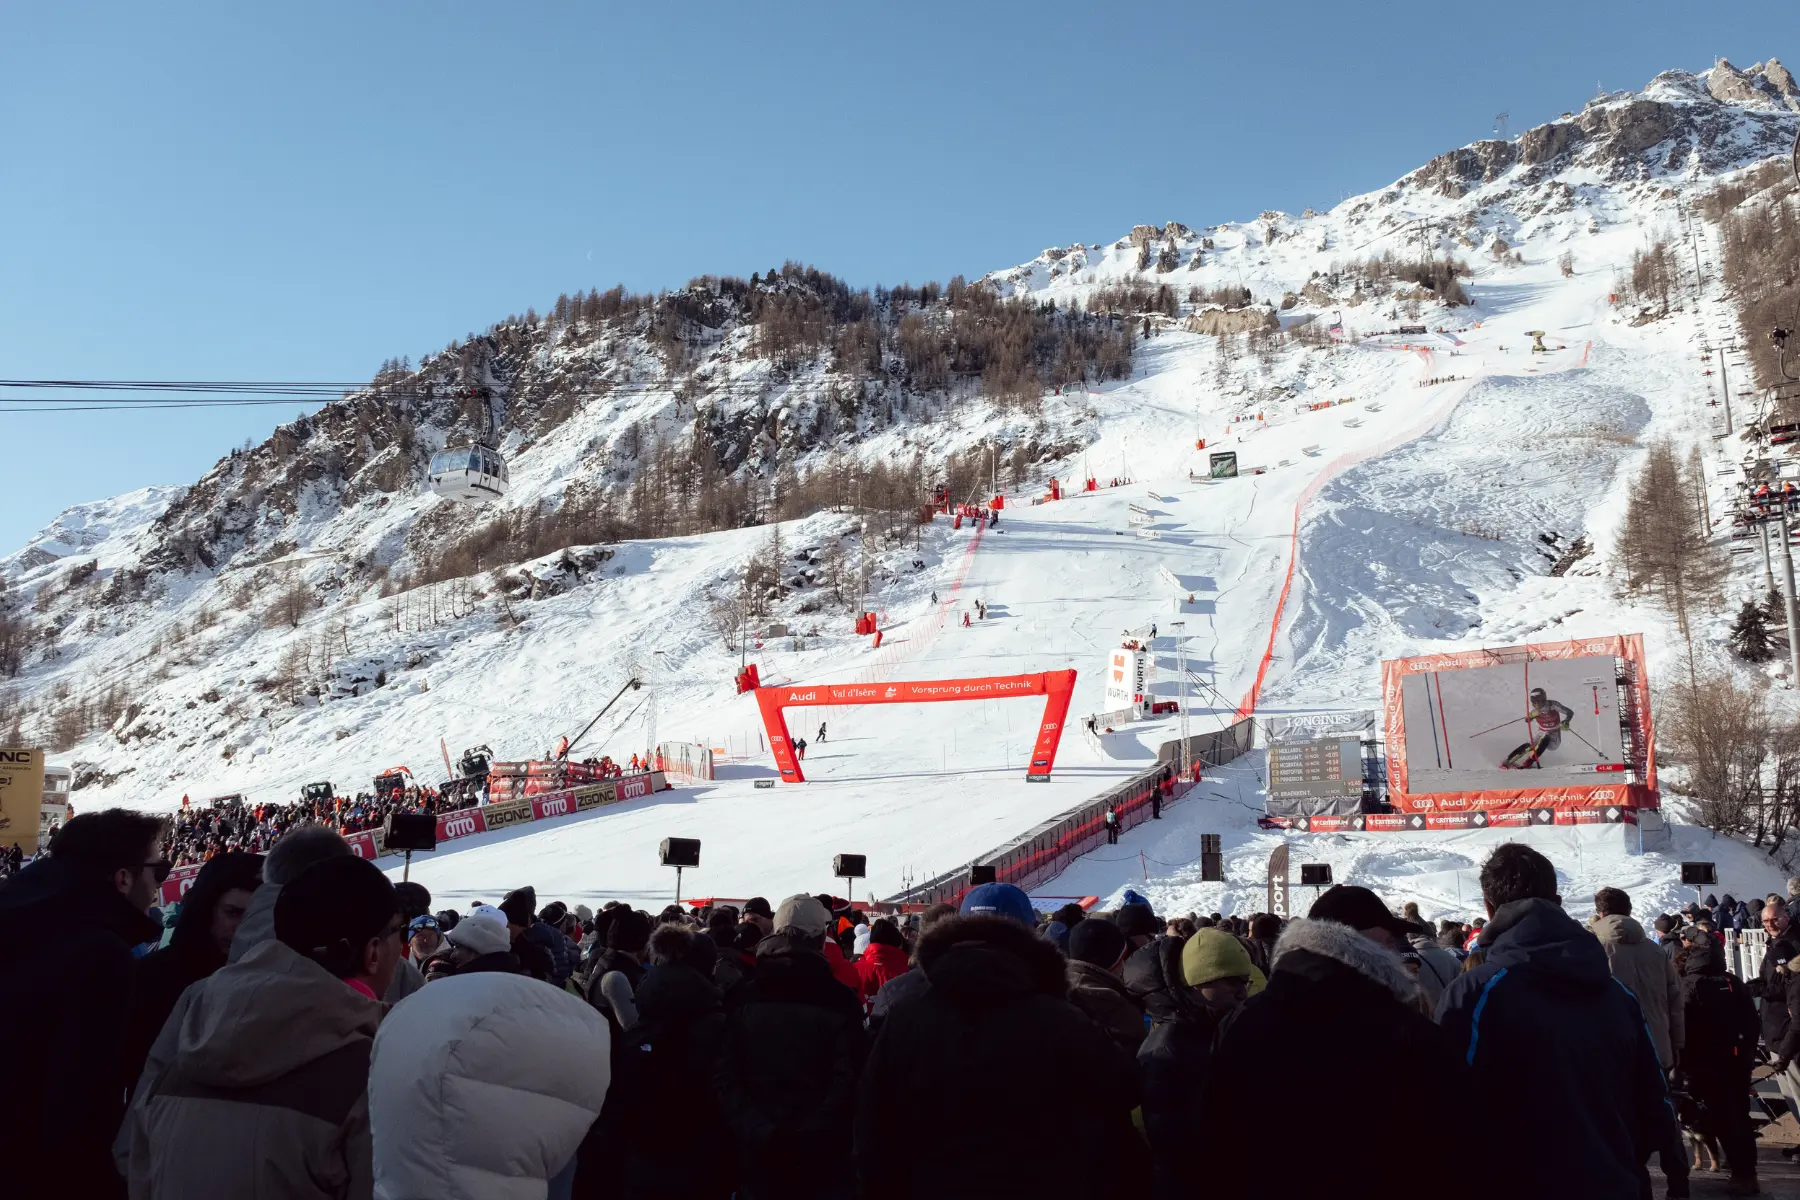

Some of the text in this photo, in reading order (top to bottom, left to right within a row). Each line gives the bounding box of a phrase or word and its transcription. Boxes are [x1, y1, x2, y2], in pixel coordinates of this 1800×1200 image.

[1437, 658, 1462, 668] Audi
[832, 688, 876, 698] Val d'Isère
[911, 680, 1032, 694] Vorsprung durch Technik
[789, 692, 816, 702] Audi
[1108, 688, 1128, 702] WÜRTH
[1286, 714, 1351, 728] LONGINES
[1389, 705, 1397, 734] World
[1638, 724, 1648, 758] World
[1392, 754, 1400, 768] FIS
[624, 782, 645, 798] OTTO
[578, 790, 615, 806] ZGONC
[1440, 798, 1466, 806] Audi
[1470, 798, 1518, 806] Vorsprung
[542, 798, 567, 816] OTTO
[486, 808, 530, 826] ZGONC
[446, 818, 475, 837] OTTO
[1272, 875, 1287, 916] port
